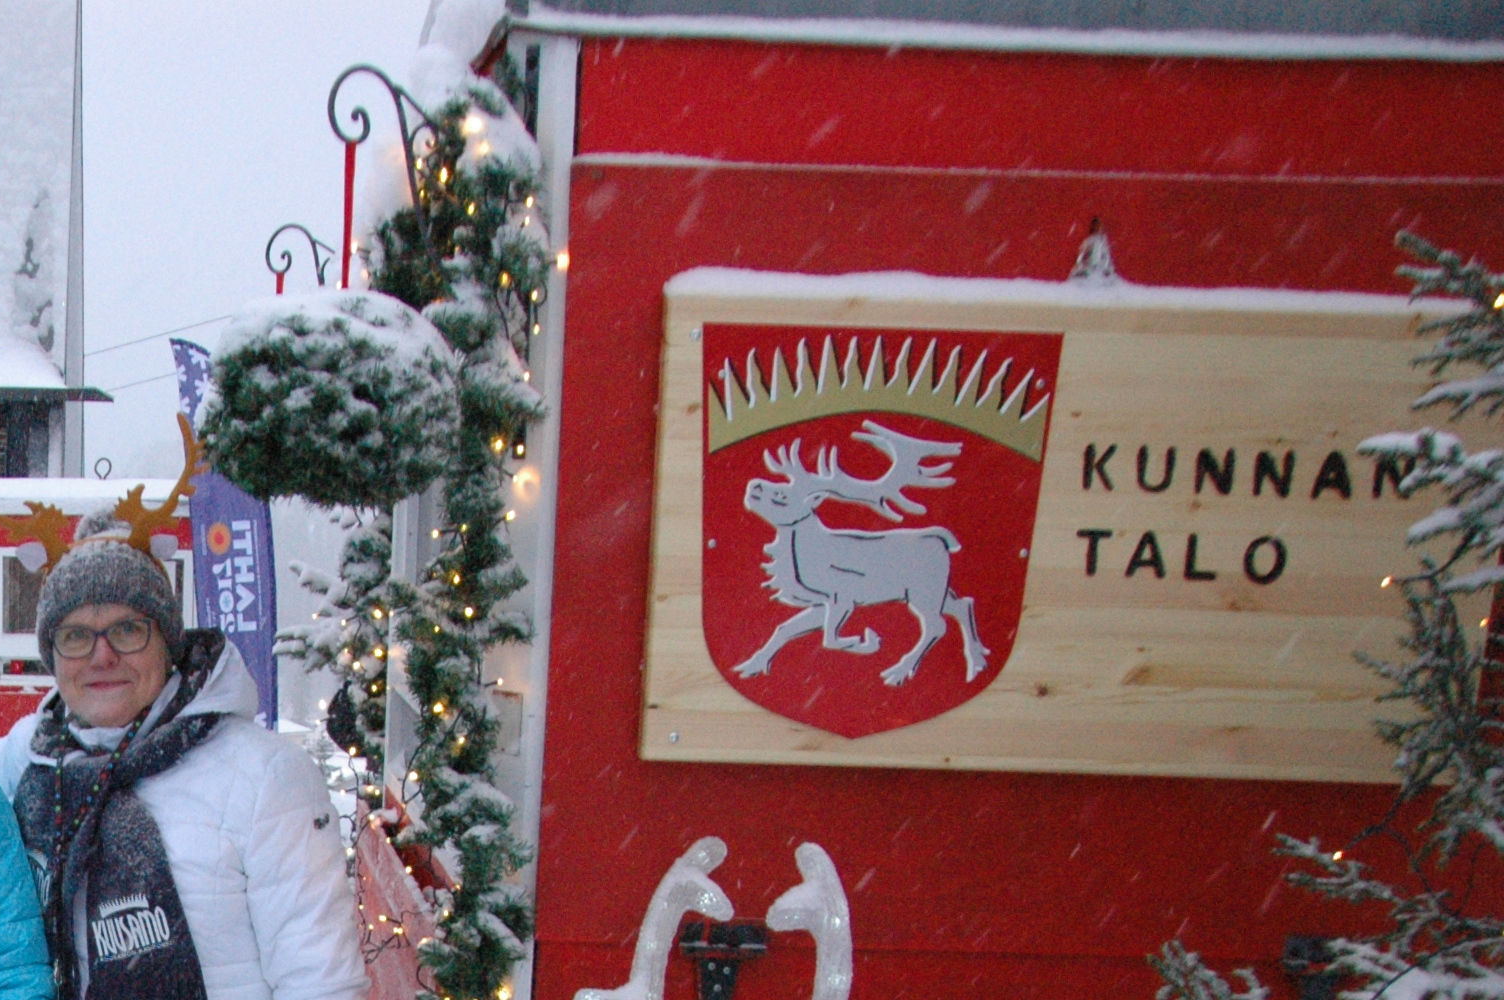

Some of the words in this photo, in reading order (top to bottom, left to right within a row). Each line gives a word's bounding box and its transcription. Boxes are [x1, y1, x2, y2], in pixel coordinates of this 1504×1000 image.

[1080, 441, 1417, 500] KUNNAN
[1075, 527, 1288, 586] TALO
[91, 905, 170, 957] KUUSAMO
